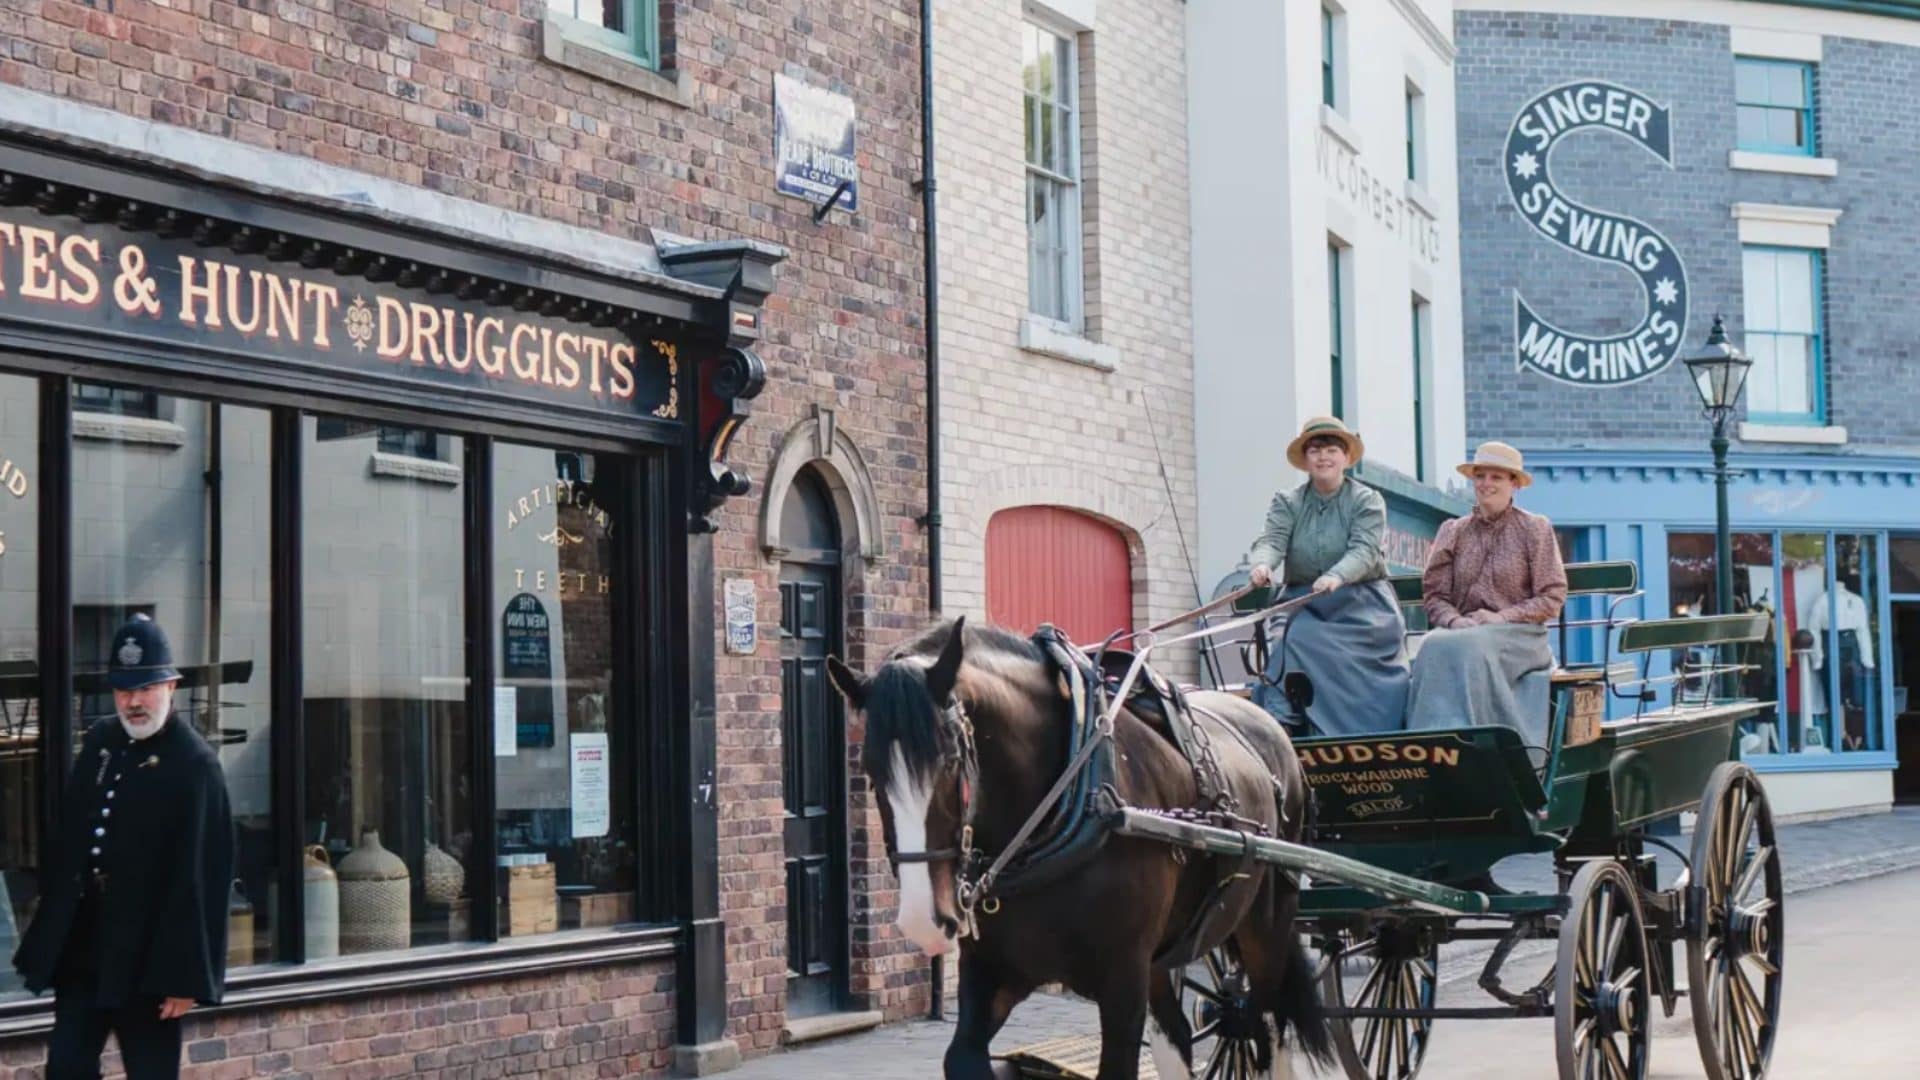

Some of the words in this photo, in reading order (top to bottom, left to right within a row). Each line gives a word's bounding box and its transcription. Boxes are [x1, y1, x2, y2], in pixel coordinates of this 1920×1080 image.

[1518, 86, 1652, 151] SINGER
[1521, 182, 1663, 272] SEWING
[113, 244, 160, 313] &
[178, 255, 338, 347] HUNT
[376, 297, 637, 398] DRUGGISTS
[1519, 311, 1679, 381] MACHINES
[507, 479, 614, 538] ARTIFICIAL
[515, 569, 609, 594] TEETH
[1299, 743, 1460, 767] HUDSON
[1343, 782, 1394, 795] WOOD
